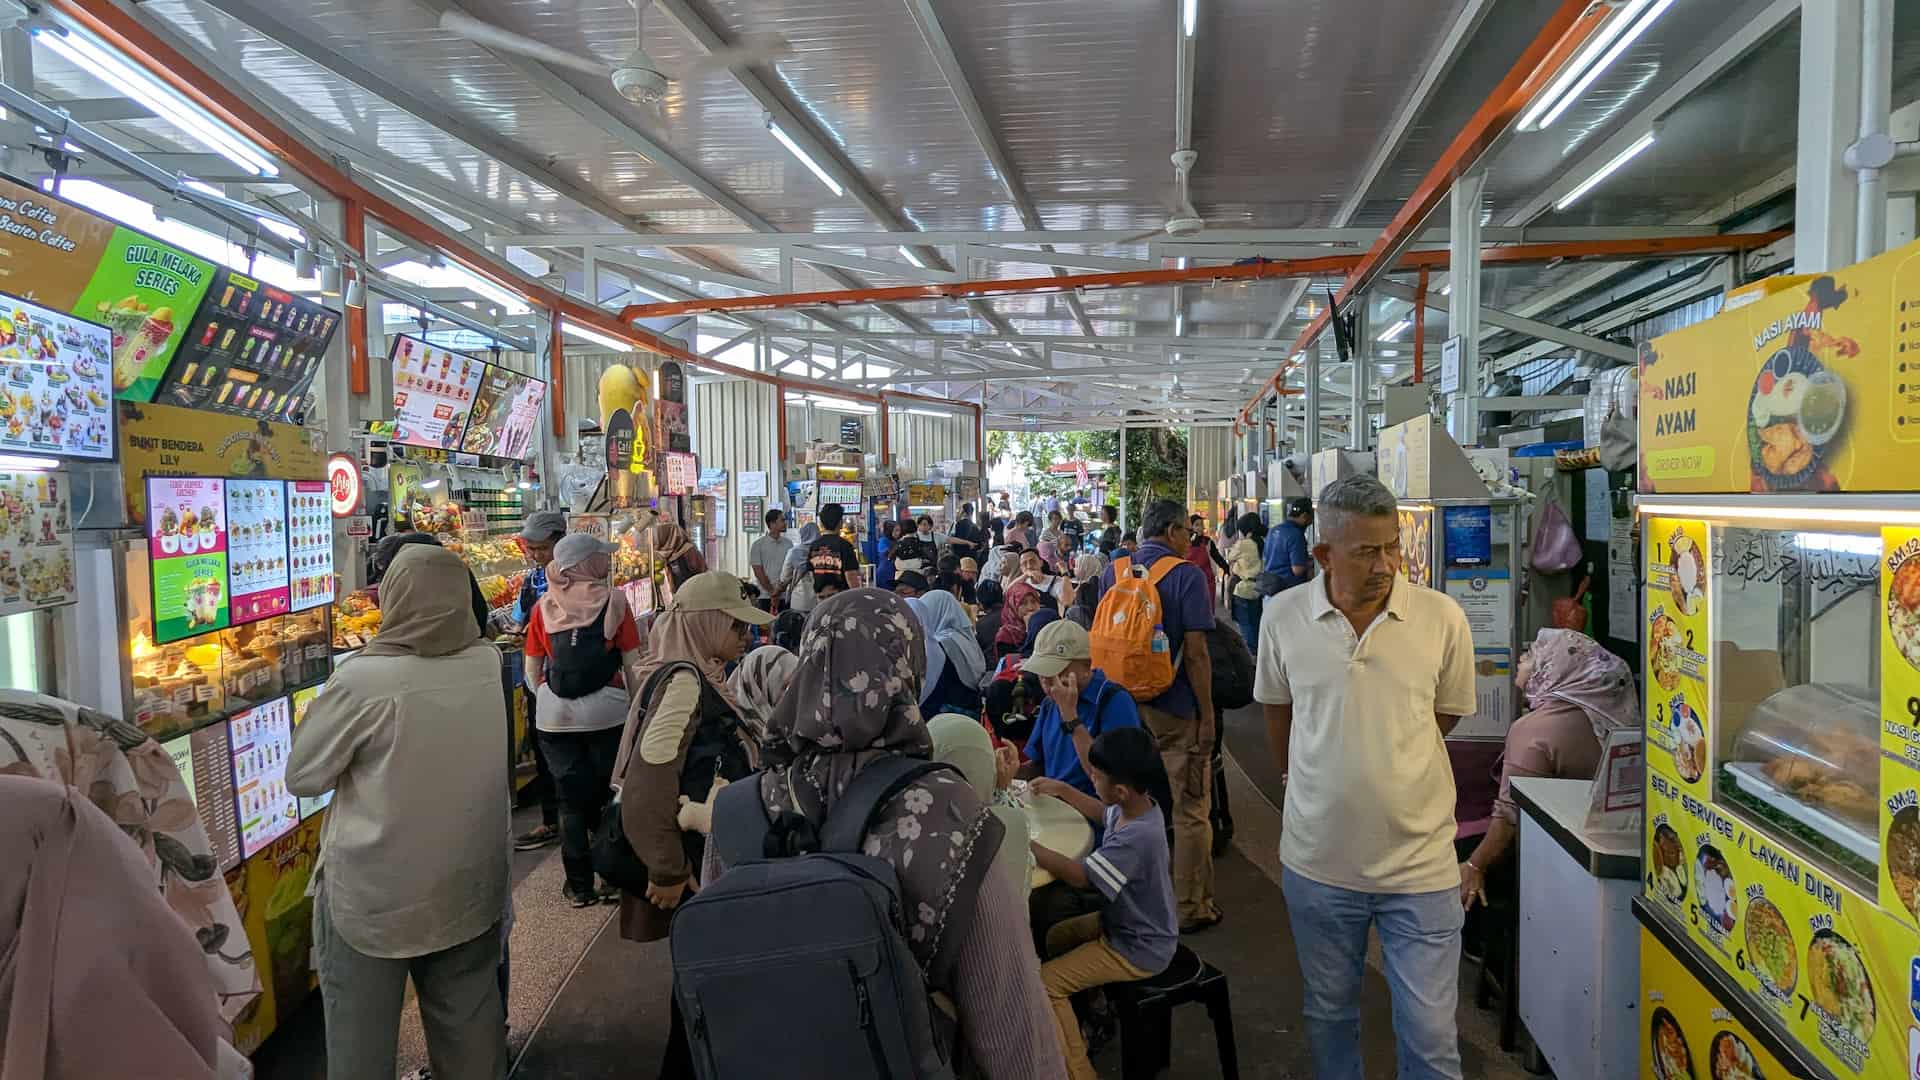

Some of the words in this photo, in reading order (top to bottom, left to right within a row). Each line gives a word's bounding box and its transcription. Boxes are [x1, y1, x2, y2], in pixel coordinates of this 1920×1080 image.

[19, 201, 57, 225] Coffee
[39, 229, 76, 252] Coffee
[126, 245, 158, 265] GULA
[160, 252, 202, 287] MELAKA
[136, 270, 180, 297] SERIES
[1754, 321, 1782, 351] NASI
[1784, 311, 1822, 331] AYAM
[1665, 372, 1697, 400] NASI
[1656, 408, 1696, 437] AYAM
[129, 435, 160, 450] BUKIT
[161, 437, 204, 452] BENDERA
[160, 453, 180, 466] LILY
[1657, 542, 1662, 563] 1
[1886, 547, 1907, 571] RM
[1686, 629, 1694, 651] 2
[1656, 703, 1664, 722] 3
[1885, 719, 1911, 739] NASI
[1650, 774, 1679, 802] SELF
[1681, 795, 1734, 841] SERVICE
[1749, 843, 1800, 886] LAYAN
[1804, 872, 1842, 914] DIRI
[1689, 904, 1698, 925] 5
[1809, 914, 1824, 931] RM
[1825, 913, 1832, 929] 9
[1736, 948, 1745, 971] 6
[1797, 993, 1810, 1021] 7
